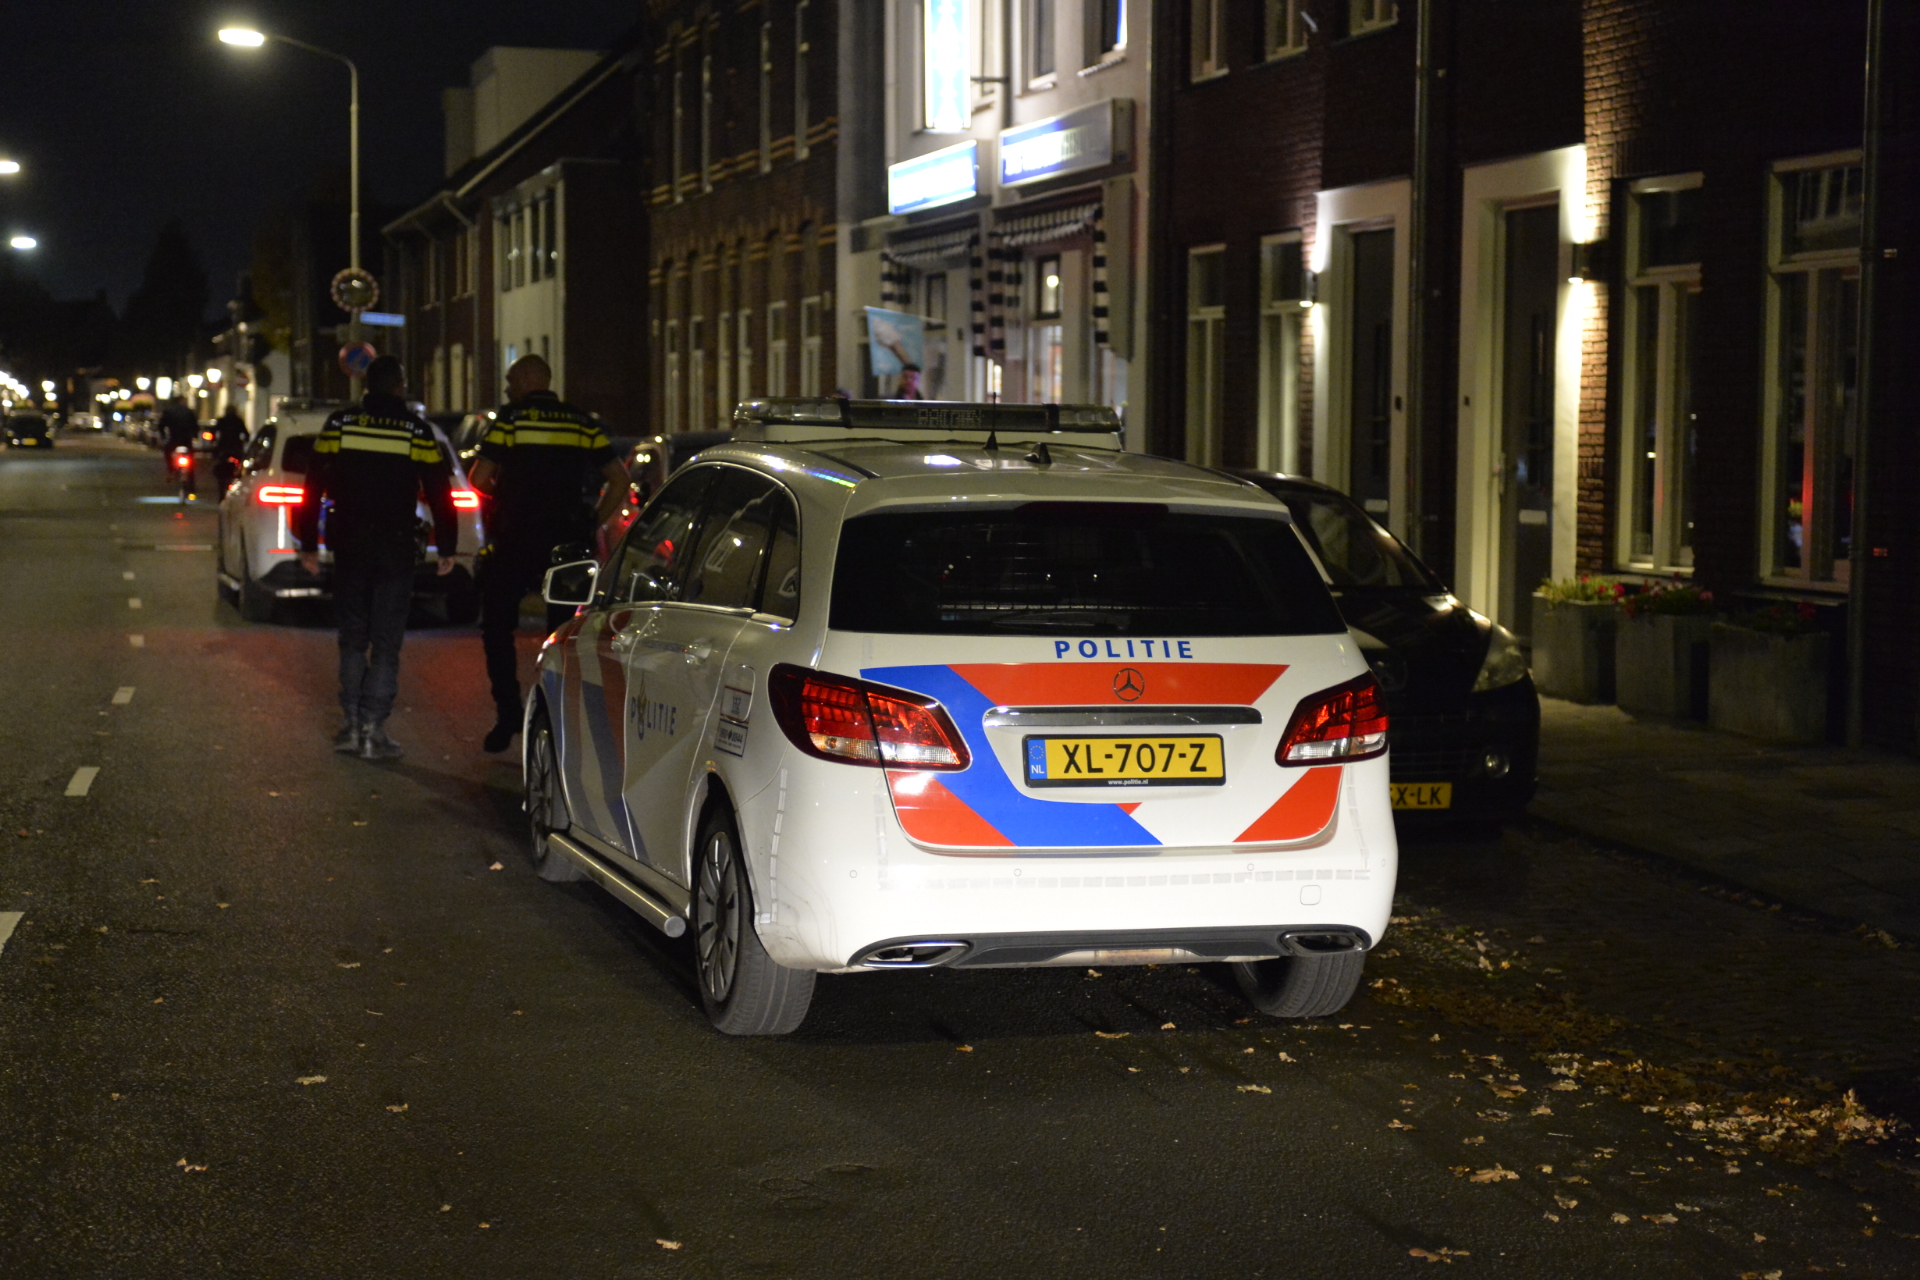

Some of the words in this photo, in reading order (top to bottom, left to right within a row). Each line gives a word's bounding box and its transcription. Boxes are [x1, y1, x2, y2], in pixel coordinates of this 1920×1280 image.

[1054, 639, 1193, 659] POLITIE
[630, 696, 677, 741] POLITIE
[1062, 743, 1208, 774] XL-707-Z
[1031, 765, 1045, 775] NL
[1390, 786, 1443, 806] X-LK
